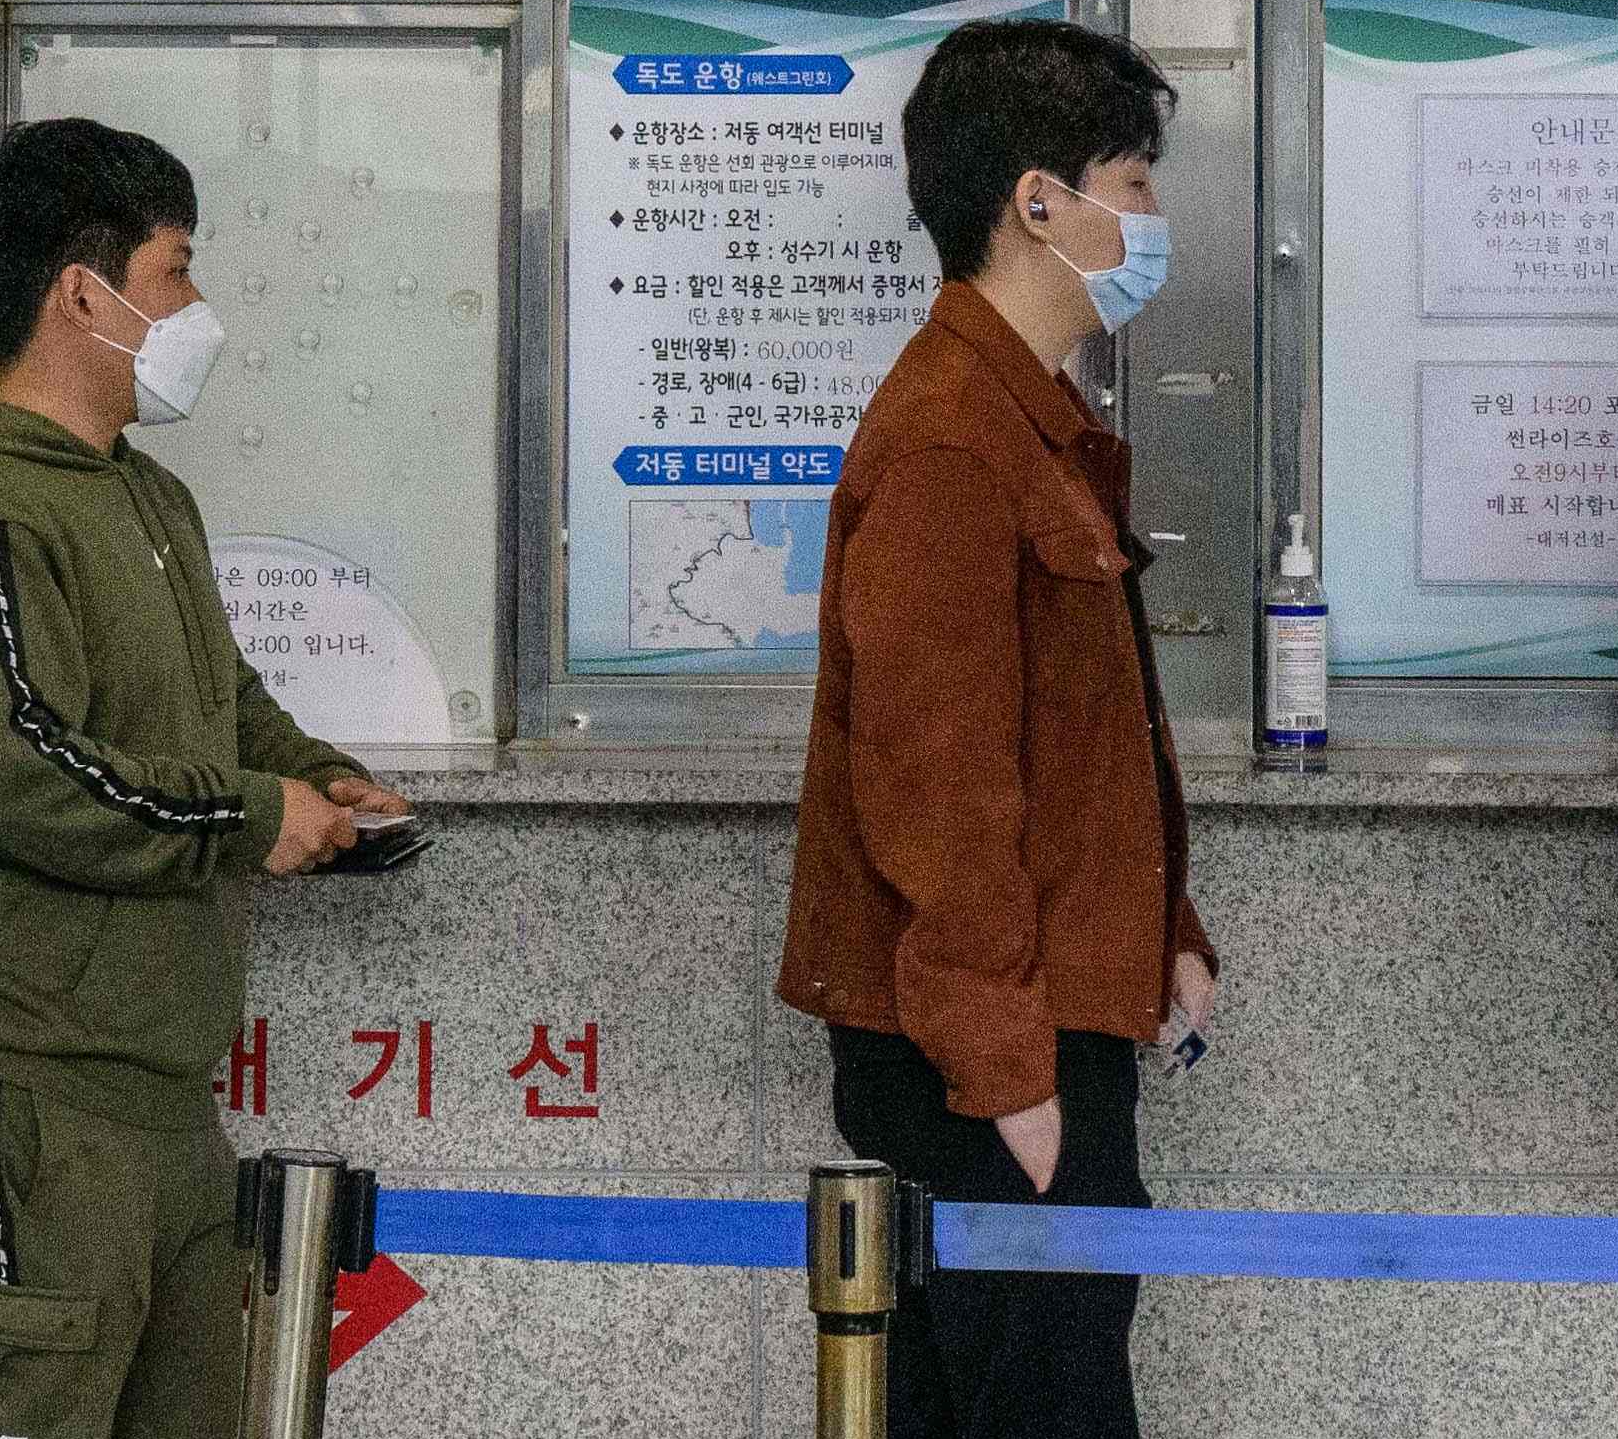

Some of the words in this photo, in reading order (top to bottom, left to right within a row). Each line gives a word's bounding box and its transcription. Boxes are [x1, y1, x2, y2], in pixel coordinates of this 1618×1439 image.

[635, 61, 685, 90] 독도
[693, 61, 744, 91] 운항
[632, 121, 705, 146] 운항장소
[724, 121, 760, 146] 저동
[766, 121, 822, 145] 여객선
[828, 121, 884, 146] 터미널
[1530, 116, 1615, 146] 안내문
[647, 154, 674, 173] 독도
[679, 153, 721, 174] 운항은
[726, 154, 755, 173] 선회
[759, 153, 817, 174] 관광으로
[647, 179, 675, 198] 현지
[679, 179, 724, 199] 사정에
[728, 179, 759, 195] 따라
[762, 179, 792, 198] 입도
[797, 178, 825, 199] 가능
[1471, 393, 1514, 416] 금일
[1533, 395, 1592, 415] 14:20
[636, 451, 686, 482] 저동
[695, 452, 771, 481] 터미널
[781, 452, 831, 480] 약도
[1487, 494, 1529, 516] 매표
[256, 568, 318, 588] 09:00
[329, 564, 372, 590] 부터
